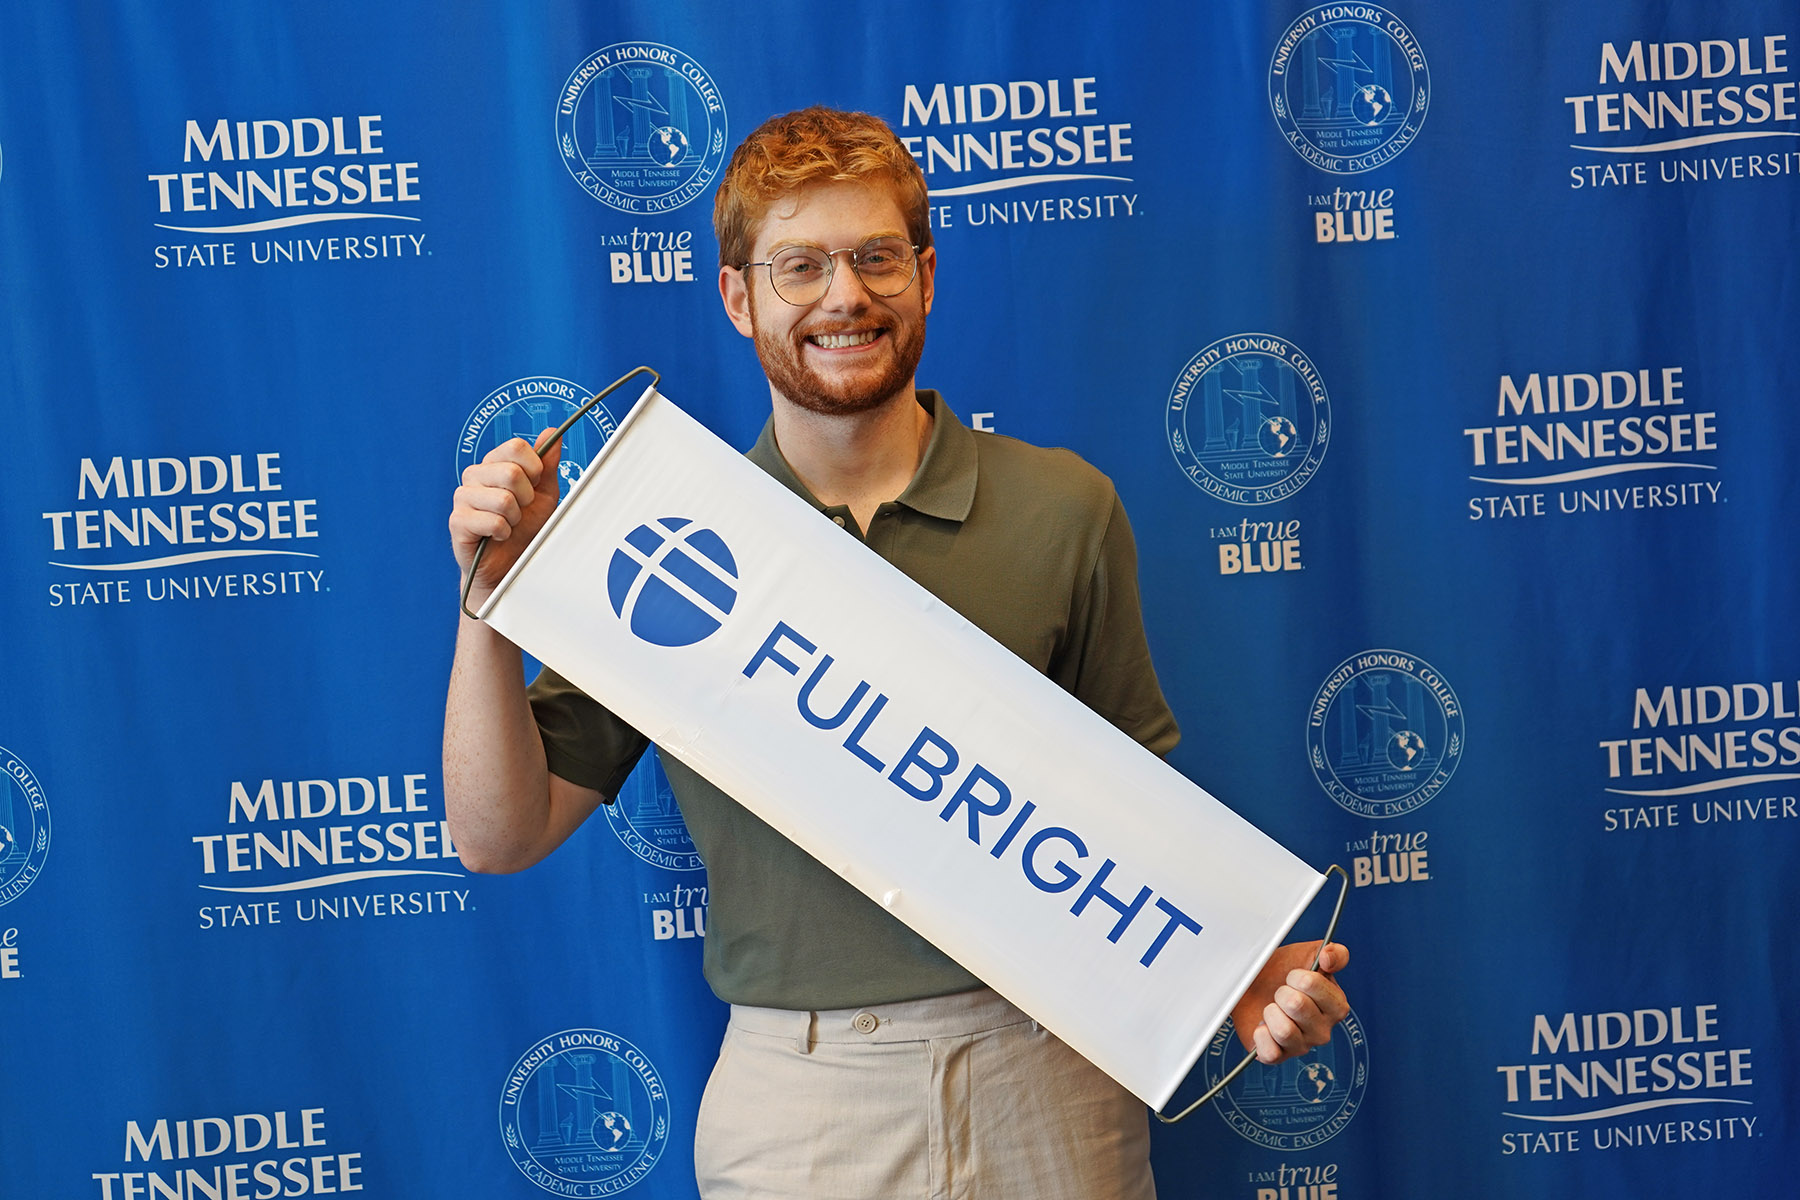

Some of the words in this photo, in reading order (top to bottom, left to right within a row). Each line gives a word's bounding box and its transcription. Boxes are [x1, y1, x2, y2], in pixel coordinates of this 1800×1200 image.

[1273, 14, 1317, 75] UNIVERSITY
[1321, 6, 1383, 23] HONORS
[1386, 20, 1424, 72] COLLEGE
[1599, 35, 1788, 84] MIDDLE
[561, 52, 611, 115] UNIVERSITY
[615, 47, 677, 65] HONORS
[681, 62, 721, 114] COLLEGE
[902, 77, 1098, 127] MIDDLE
[1564, 82, 1800, 134] TENNESSE
[183, 114, 384, 162] MIDDLE
[900, 123, 1133, 175] ENNESSEE
[1287, 130, 1343, 171] ACADEMIC
[1349, 122, 1417, 171] EXCELLENCE
[148, 162, 421, 212] TENNESSEE
[575, 170, 640, 210] ACADEMIC
[646, 165, 714, 211] EXCELLENCE
[1308, 195, 1312, 205] I
[1314, 195, 1331, 205] AM
[1333, 186, 1394, 211] true
[1570, 162, 1647, 189] STATE
[154, 243, 236, 268] STATE
[601, 235, 605, 246] I
[607, 235, 628, 246] AM
[630, 227, 692, 251] true
[1171, 347, 1221, 411] UNIVERSITY
[1226, 338, 1287, 356] HONORS
[1291, 353, 1326, 404] COLLEGE
[1497, 367, 1684, 417] MIDDLE
[461, 389, 511, 454] UNIVERSITY
[516, 381, 576, 399] HONORS
[581, 397, 615, 440] COLLE
[1463, 412, 1717, 466] TENNESSEE
[78, 452, 282, 500] MIDDLE
[1186, 463, 1249, 502] ACADEMIC
[1256, 455, 1320, 502] EXCELLENCE
[42, 499, 319, 551] TENNESSEE
[1210, 528, 1215, 538] I
[1217, 527, 1237, 538] AM
[1240, 517, 1300, 542] true
[1469, 494, 1545, 520] STATE
[49, 581, 131, 607] STATE
[1311, 663, 1354, 727] UNIVERSITY
[1358, 654, 1415, 672] HONORS
[1420, 668, 1458, 718] COLLEGE
[1632, 680, 1800, 729] MIDDL
[7, 760, 44, 811] COLLEGE
[228, 773, 428, 824] MIDDLE
[742, 620, 1203, 968] FULBRIGHT
[1325, 779, 1380, 816] ACADEMIC
[1385, 768, 1450, 815] EXCELLENCE
[1346, 842, 1351, 852] I
[1353, 840, 1369, 851] AM
[1370, 830, 1428, 854] true
[1604, 804, 1679, 832] STATE
[619, 829, 683, 868] ACADEMIC
[0, 862, 38, 900] LLENCE
[644, 893, 648, 903] I
[650, 892, 670, 903] AM
[199, 902, 281, 929] STATE
[652, 906, 708, 940] BLU
[1531, 1004, 1719, 1055] MIDDLE
[504, 1041, 555, 1105] UNIVERSITY
[559, 1033, 620, 1052] HONORS
[625, 1050, 664, 1101] COLLEGE
[1497, 1048, 1752, 1102] TENNESSEE
[124, 1107, 327, 1162] MIDDLE
[1225, 1110, 1288, 1148] ACADEMIC
[1293, 1100, 1357, 1148] EXCELLENCE
[1502, 1130, 1580, 1154] STATE
[92, 1152, 363, 1200] TENNESSEE
[519, 1160, 584, 1195] ACADEMIC
[590, 1150, 656, 1195] EXCELLENCE
[1248, 1172, 1253, 1182] I
[1255, 1172, 1275, 1182] AM
[1277, 1163, 1338, 1186] true
